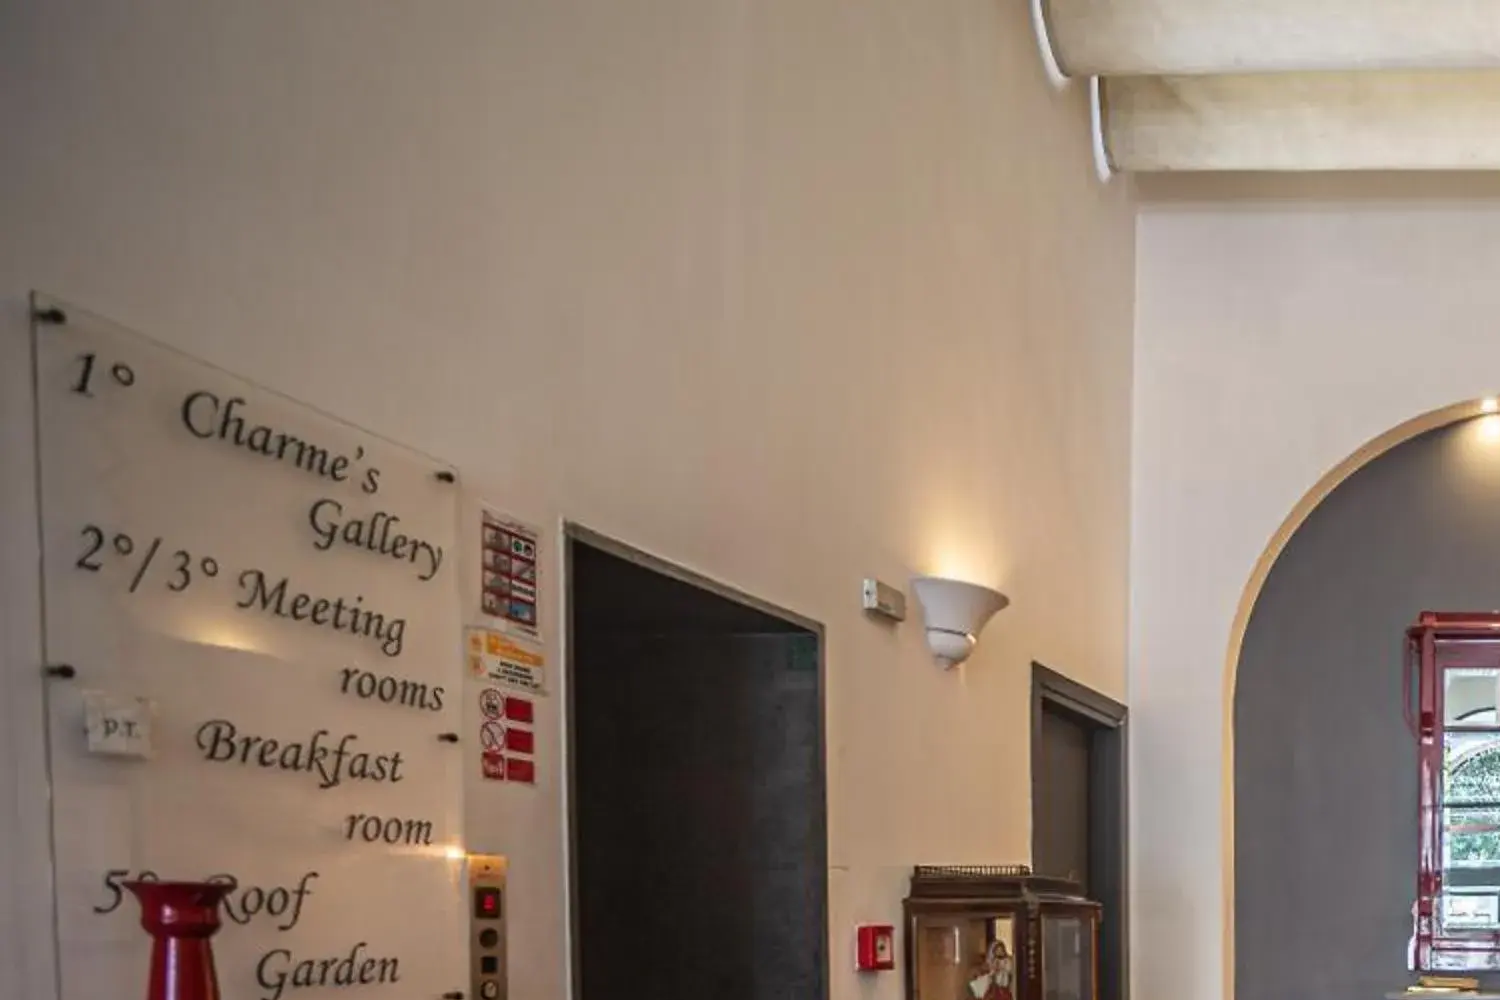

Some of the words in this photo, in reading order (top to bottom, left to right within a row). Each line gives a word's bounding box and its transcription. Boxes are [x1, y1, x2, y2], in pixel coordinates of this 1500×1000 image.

[181, 390, 381, 494] Charme's
[309, 499, 444, 581] Gallery
[236, 568, 407, 657] Meeting
[340, 666, 445, 712] rooms
[195, 719, 404, 789] Breakfast
[344, 812, 434, 846] room
[93, 869, 159, 914] 5
